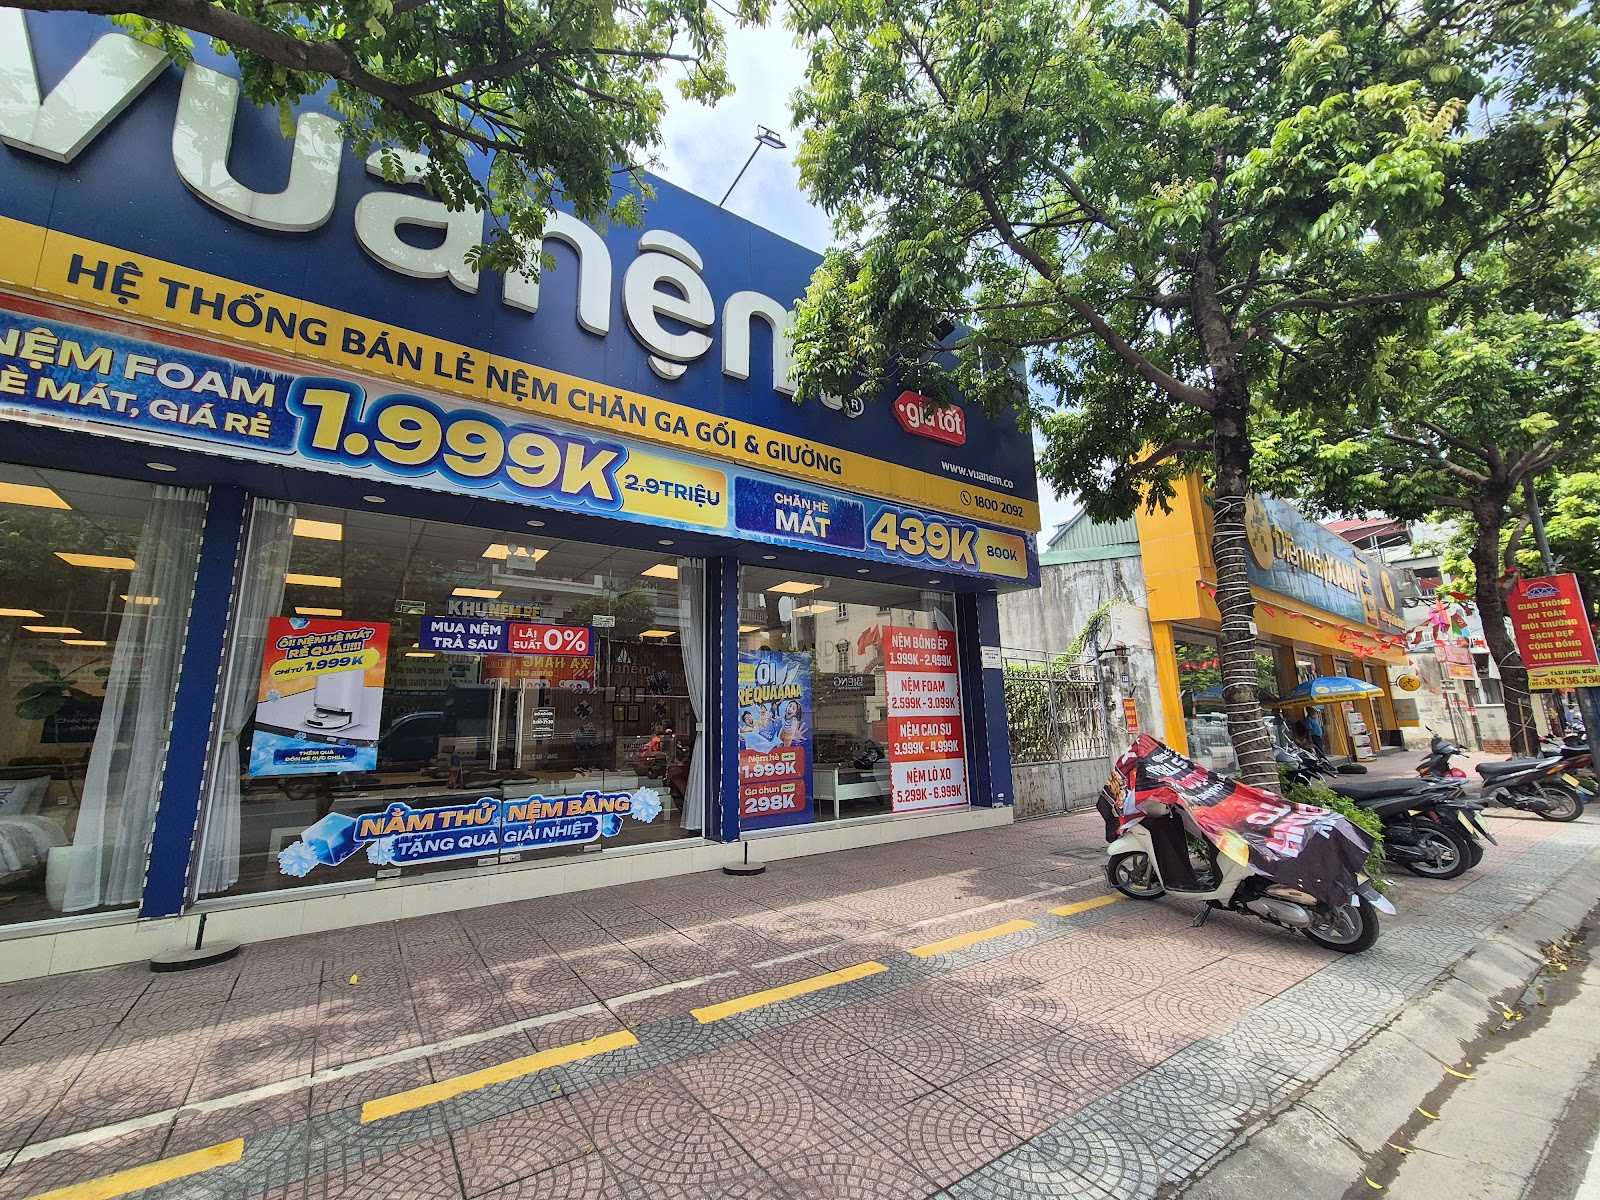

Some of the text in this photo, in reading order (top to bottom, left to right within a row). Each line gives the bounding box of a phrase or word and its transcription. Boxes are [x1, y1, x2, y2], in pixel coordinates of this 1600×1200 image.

[67, 253, 842, 475] HỆ THỐNG BÁN LẺ NỆM CHĂN GA GỐI & GIƯỜNG
[124, 352, 275, 408] FOAM
[35, 376, 140, 418] MÁT,
[149, 398, 217, 430] GIÁ
[223, 409, 272, 439] RẺ
[937, 407, 963, 435] tốt
[303, 388, 619, 501] 1.999K
[940, 460, 1014, 489] www.vuanem.co
[624, 474, 720, 508] 2.9TRIỆU
[773, 492, 829, 514] CHĂN HÈ
[974, 495, 1024, 518] 1800 2092
[774, 508, 831, 539] MÁT
[870, 511, 976, 566] 439K
[986, 544, 1018, 561] 800K
[447, 599, 488, 617] KHU
[1517, 598, 1571, 611] GIAO THÔNG
[1527, 609, 1566, 620] AN TOÀN
[431, 621, 501, 637] MUA NỆM
[519, 629, 537, 638] LÃI
[1521, 618, 1578, 631] MÔI TRƯỜNG
[297, 634, 327, 647] NỆM
[328, 632, 344, 642] HÈ
[345, 628, 373, 640] MÁT
[433, 635, 498, 650] TRẢ SAU
[513, 638, 542, 649] SUẤT
[543, 629, 587, 652] 0%
[892, 633, 948, 651] NỆM BÔNG ÉP
[1529, 629, 1575, 641] SẠCH ĐẸP
[288, 645, 309, 658] RẺ
[1528, 641, 1553, 651] CỘNG
[889, 654, 919, 666] 1.999K
[924, 655, 952, 667] 2.499K
[1532, 650, 1583, 661] VĂN MINH!
[901, 677, 945, 694] NỆM FOAM
[892, 697, 921, 710] 2.599K
[927, 697, 955, 709] 3.099K
[900, 720, 952, 739] NỆM CAO SU
[894, 742, 924, 756] 3.999K
[930, 740, 959, 752] 4.999K
[748, 754, 768, 764] Nệm
[769, 753, 779, 761] hè
[742, 761, 797, 779] 1.999K
[906, 767, 951, 786] NỆM LÒ XO
[744, 788, 757, 796] Ga
[758, 785, 779, 795] chun
[897, 788, 927, 803] 5.299K
[933, 784, 962, 799] 6.999K
[744, 794, 796, 814] 298K
[360, 793, 630, 837] NẰM THỬ NỆM BĂNG
[397, 821, 591, 858] TẶNG QUÀ GIẢI NHIỆT
